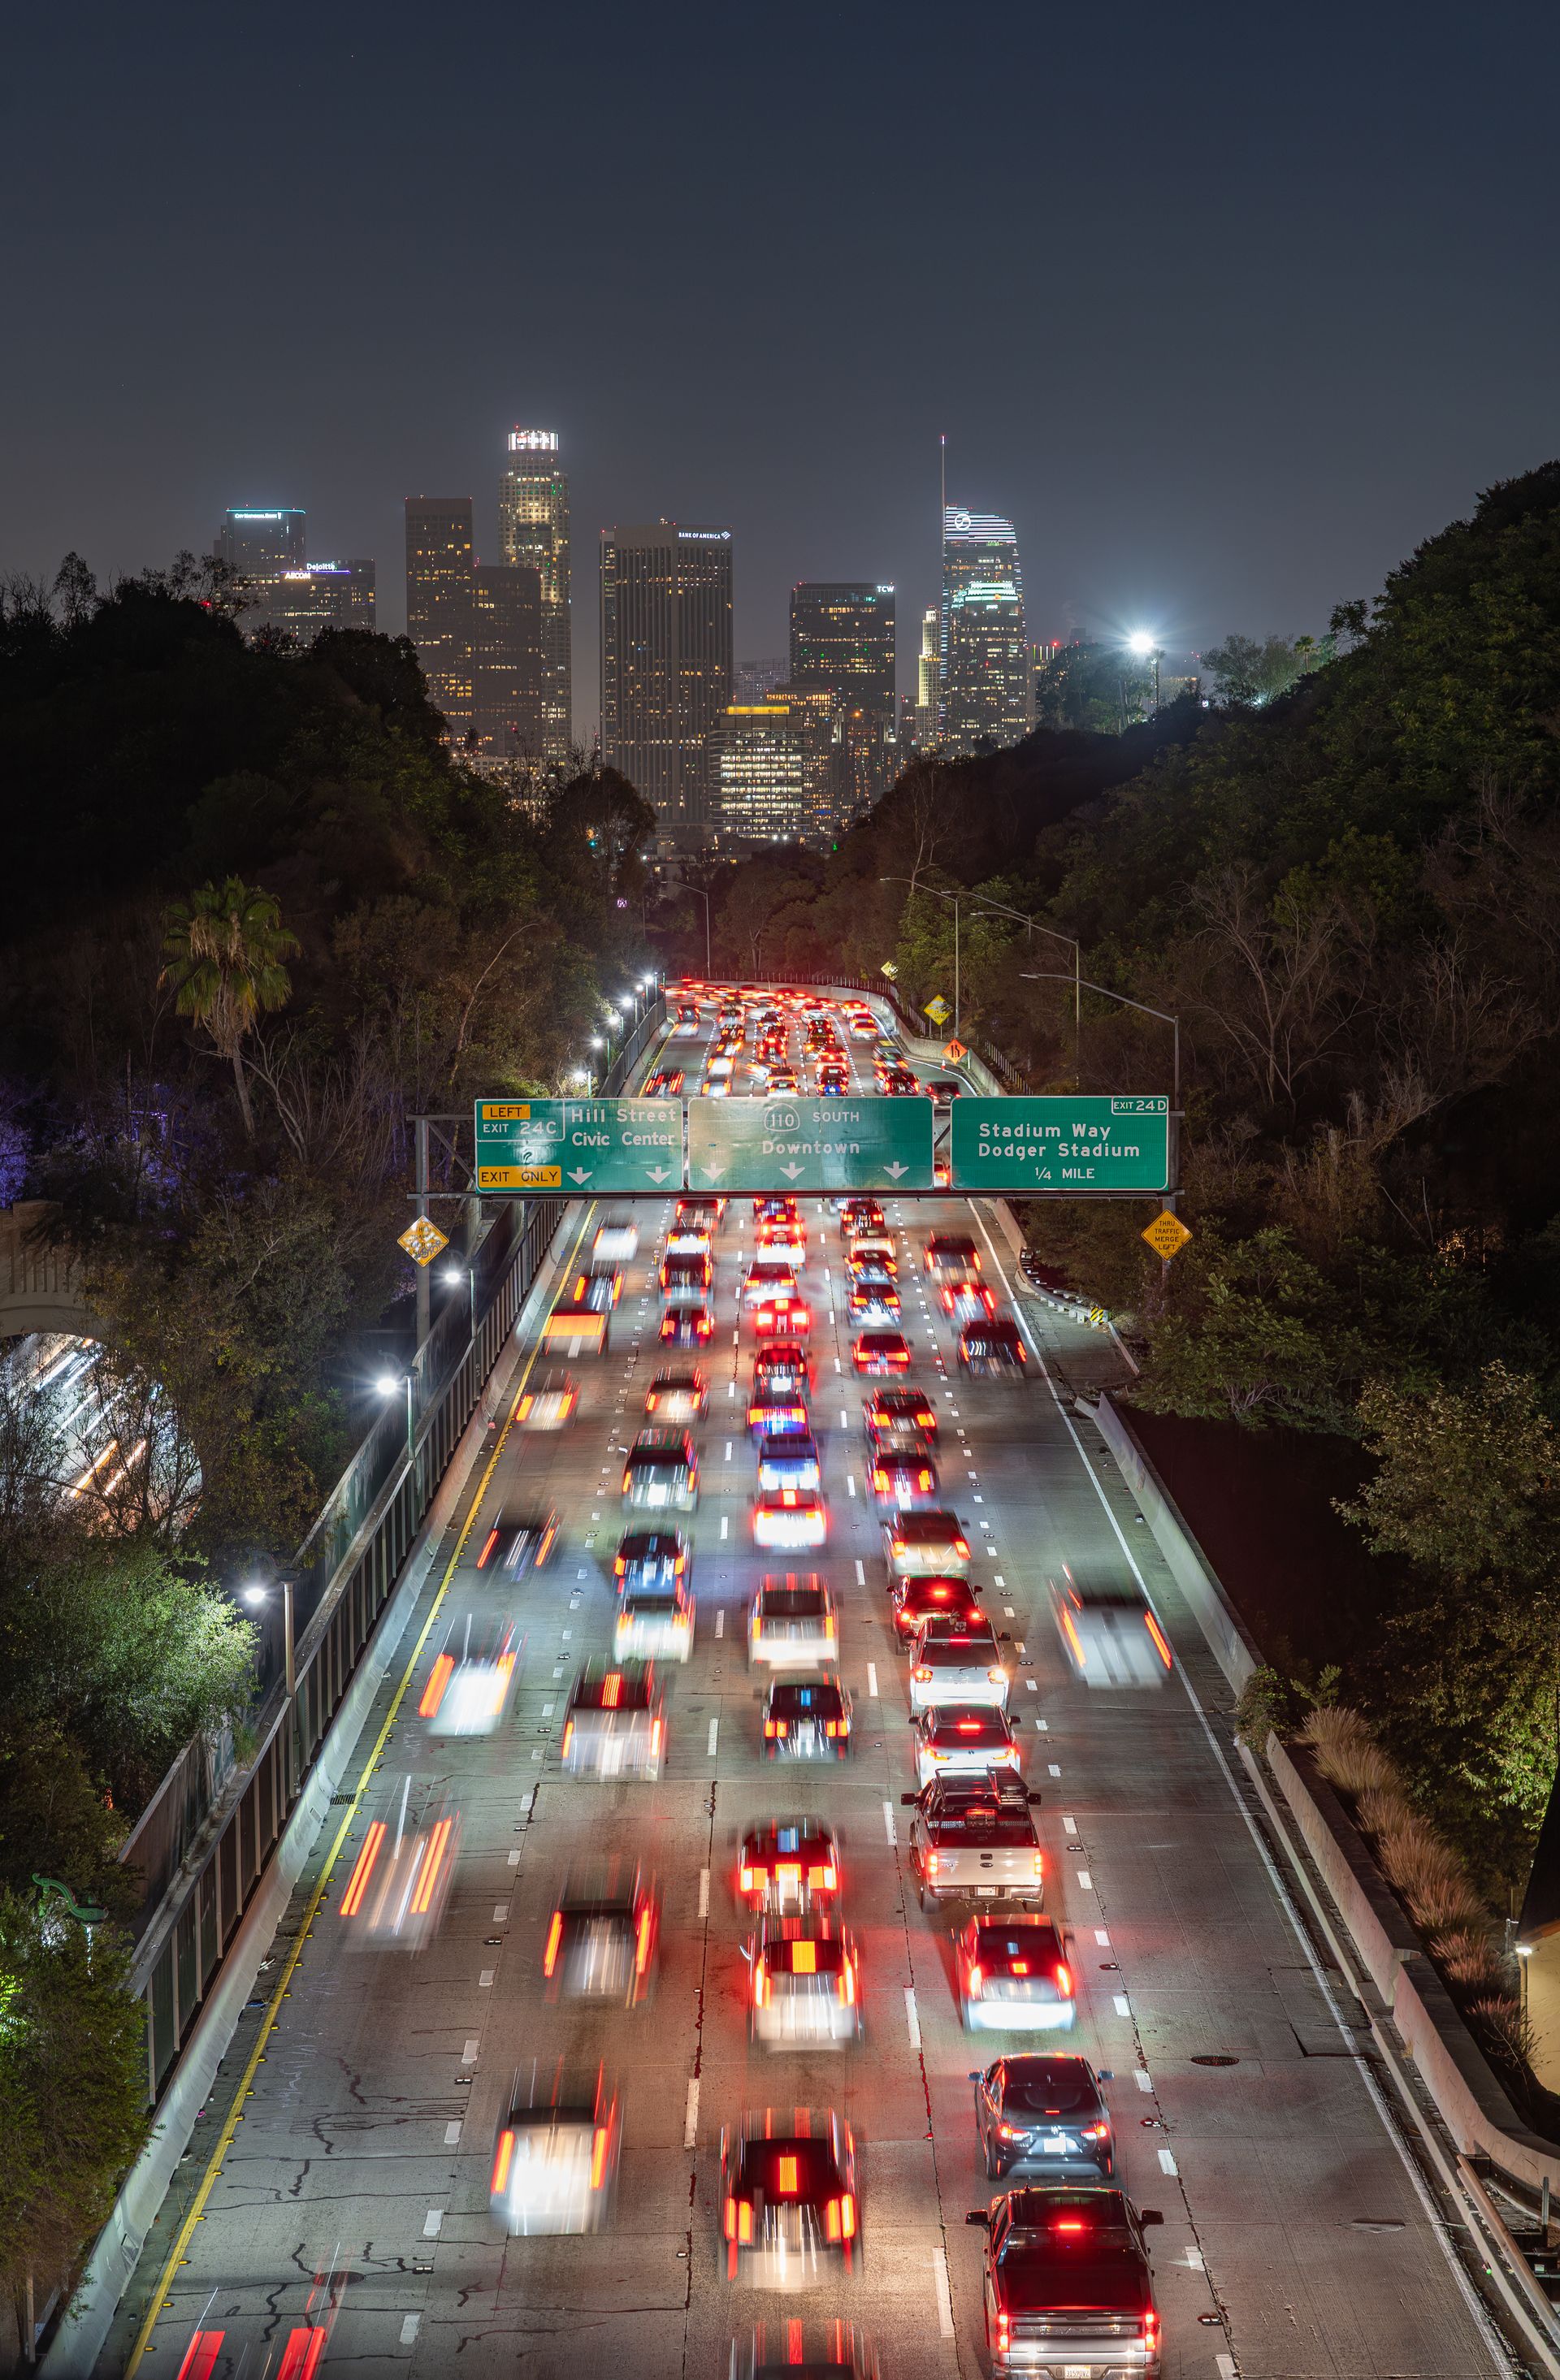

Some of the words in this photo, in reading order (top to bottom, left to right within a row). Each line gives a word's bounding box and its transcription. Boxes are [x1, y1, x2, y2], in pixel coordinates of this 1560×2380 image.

[491, 1107, 522, 1117] LEFT
[1114, 1101, 1133, 1110] EXIT
[1136, 1101, 1166, 1110] 24D
[571, 1109, 604, 1123] Hill
[617, 1108, 676, 1123] Street
[771, 1114, 794, 1127] 110
[812, 1111, 860, 1123] SOUTH
[483, 1124, 509, 1133] EXIT
[520, 1121, 557, 1135] 24C
[979, 1123, 1060, 1137] Stadium
[1072, 1123, 1111, 1140] Way
[572, 1132, 609, 1146] Civic
[622, 1132, 674, 1145] Center
[762, 1140, 860, 1154] Downtown
[978, 1144, 1046, 1161] Dodger
[1058, 1143, 1139, 1157] Stadium
[482, 1171, 509, 1182] EXIT
[521, 1171, 558, 1182] ONLY
[1063, 1168, 1094, 1179] MILE
